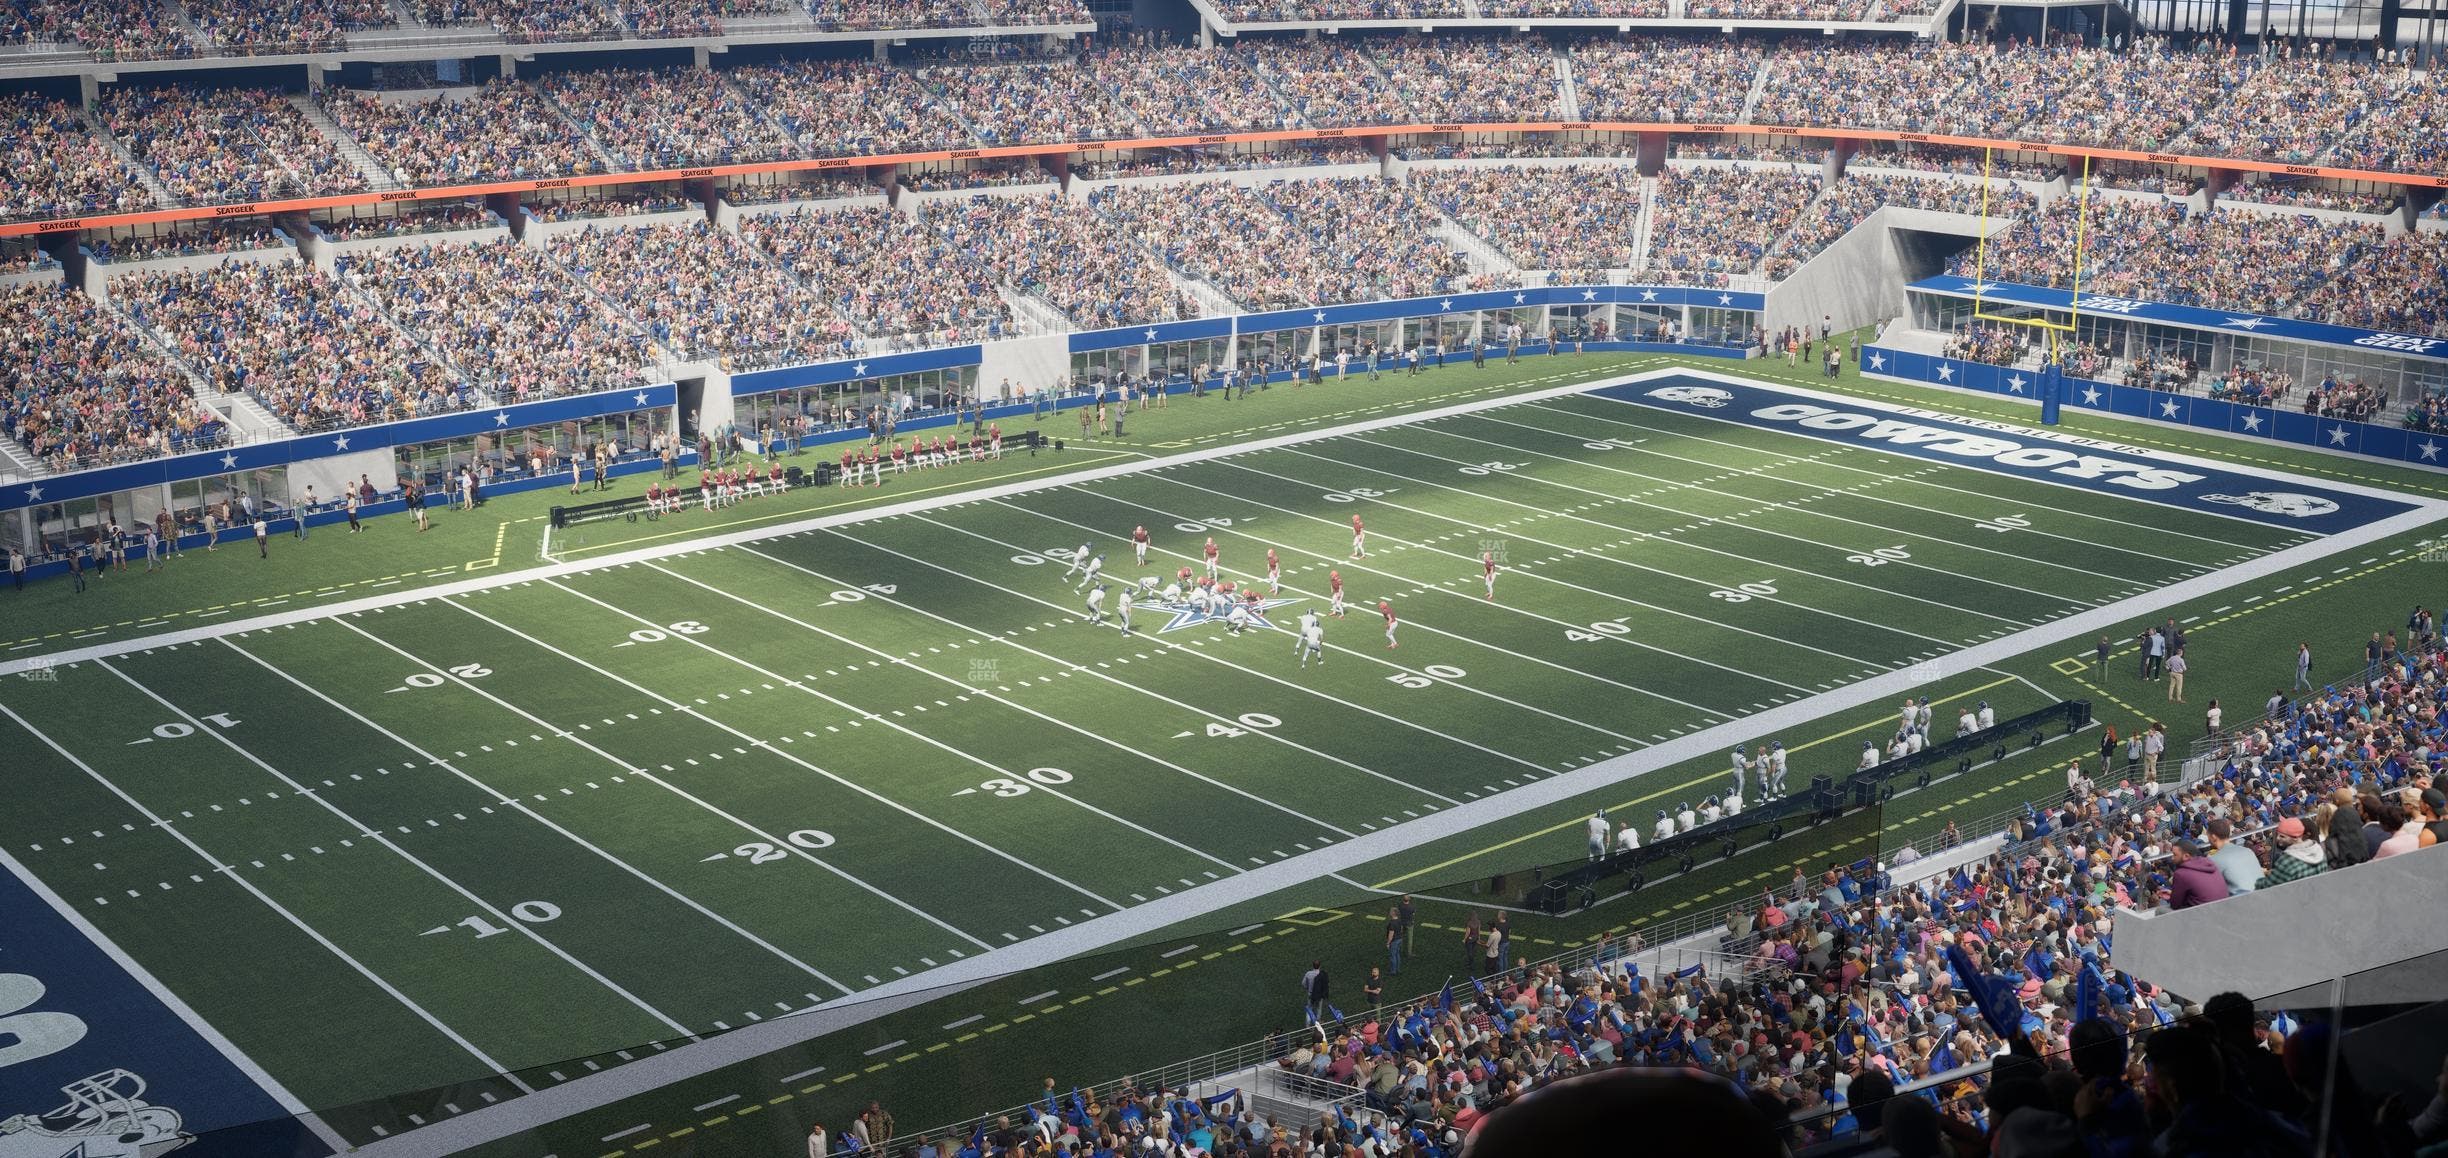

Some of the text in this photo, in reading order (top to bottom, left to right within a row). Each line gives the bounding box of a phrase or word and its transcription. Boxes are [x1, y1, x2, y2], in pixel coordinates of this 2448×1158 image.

[950, 150, 980, 158] SEATGEEK
[2020, 143, 2048, 152] SEATGEEK
[818, 159, 850, 168] SEATGEEK
[2148, 154, 2179, 163] SEATGEEK
[681, 168, 713, 177] SEATGEEK
[2286, 166, 2319, 175] SEATGEEK
[535, 179, 569, 188] SEATGEEK
[381, 191, 416, 201] SEATGEEK
[216, 205, 255, 215] SEATGEEK
[39, 220, 81, 231] SEATGEEK
[2085, 296, 2152, 307] SEAT
[2353, 338, 2435, 353] GEEK
[2369, 333, 2446, 346] SEAT
[1897, 407, 2151, 454] IT TAKES ALL OF US
[1750, 403, 2207, 490] COWBOYS
[1846, 548, 1911, 567] 20
[1709, 583, 1778, 603] 30
[1564, 622, 1632, 641] 40
[1385, 665, 1467, 688] 50
[1206, 713, 1282, 738] 40
[980, 767, 1073, 798] 30
[733, 829, 836, 865] 20
[456, 900, 562, 939] 10
